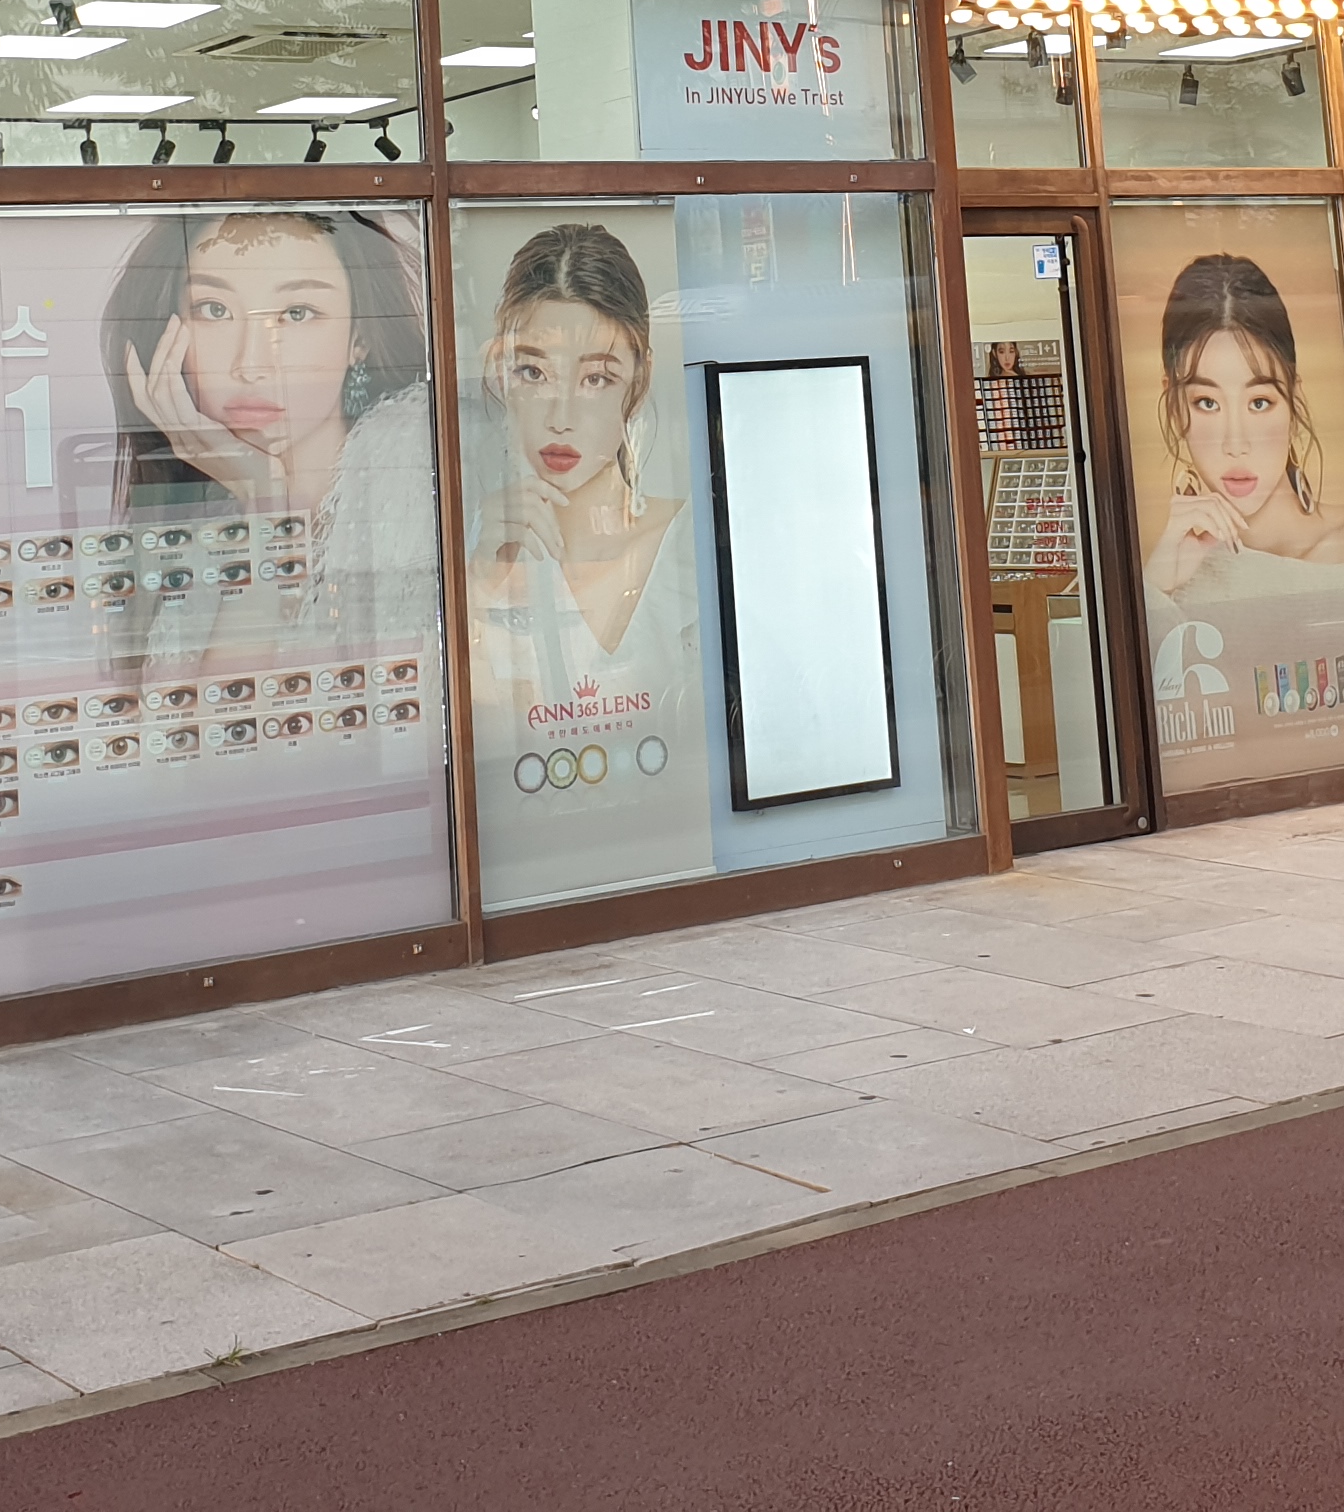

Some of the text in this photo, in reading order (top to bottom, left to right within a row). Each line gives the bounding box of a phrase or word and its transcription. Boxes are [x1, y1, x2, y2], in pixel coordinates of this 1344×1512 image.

[685, 86, 844, 106] In JINYUS We Trust
[1035, 521, 1064, 534] OPEN
[527, 691, 652, 731] ANN 365 LENS
[1156, 701, 1198, 745] Rich
[1202, 698, 1236, 739] Ann
